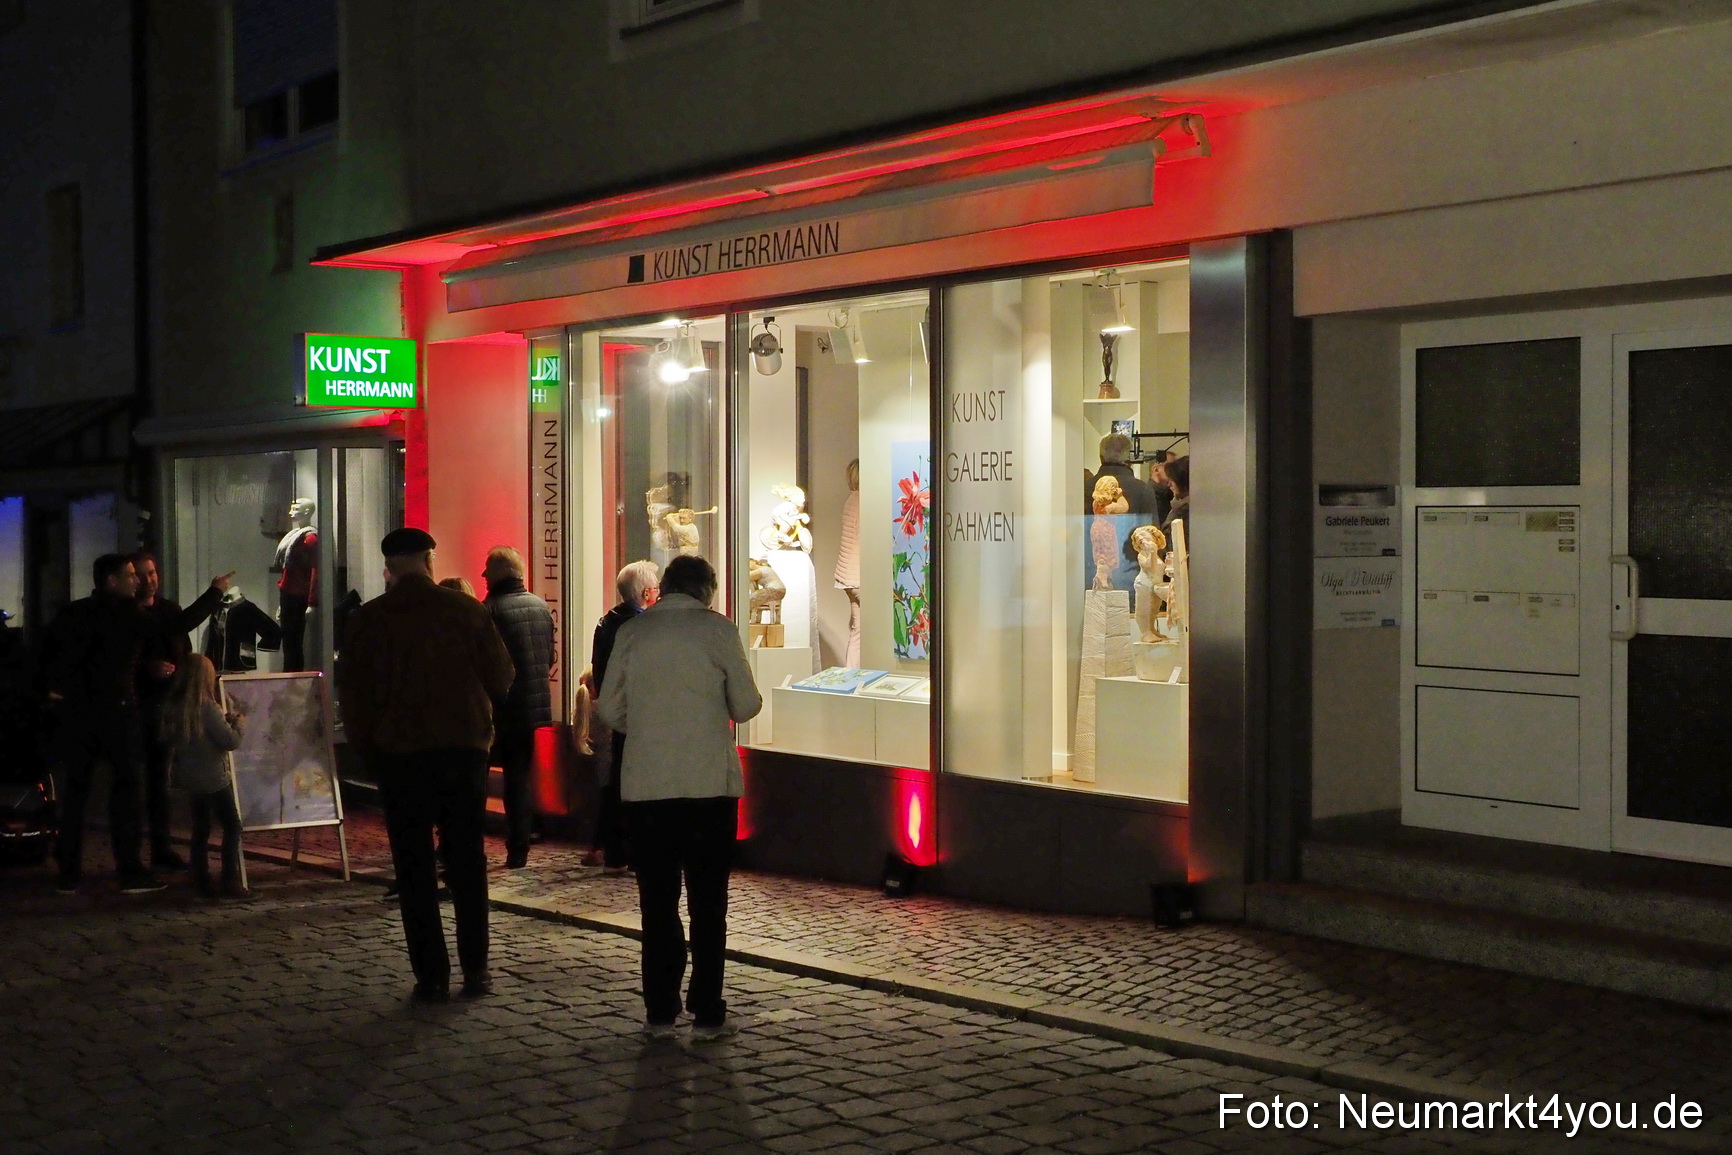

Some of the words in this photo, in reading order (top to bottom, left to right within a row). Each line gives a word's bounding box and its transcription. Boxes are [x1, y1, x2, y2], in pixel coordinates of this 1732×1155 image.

[654, 243, 713, 281] KUNST
[718, 222, 840, 269] HERRMANN
[309, 346, 391, 373] KUNST
[325, 379, 413, 398] HERRMANN
[952, 390, 1005, 423] KUNST
[946, 451, 1013, 483] GALERIE
[544, 419, 558, 580] HERRMANN
[945, 512, 1015, 541] RAHMEN
[1325, 515, 1358, 526] Gabriele
[1361, 515, 1390, 526] Peukert
